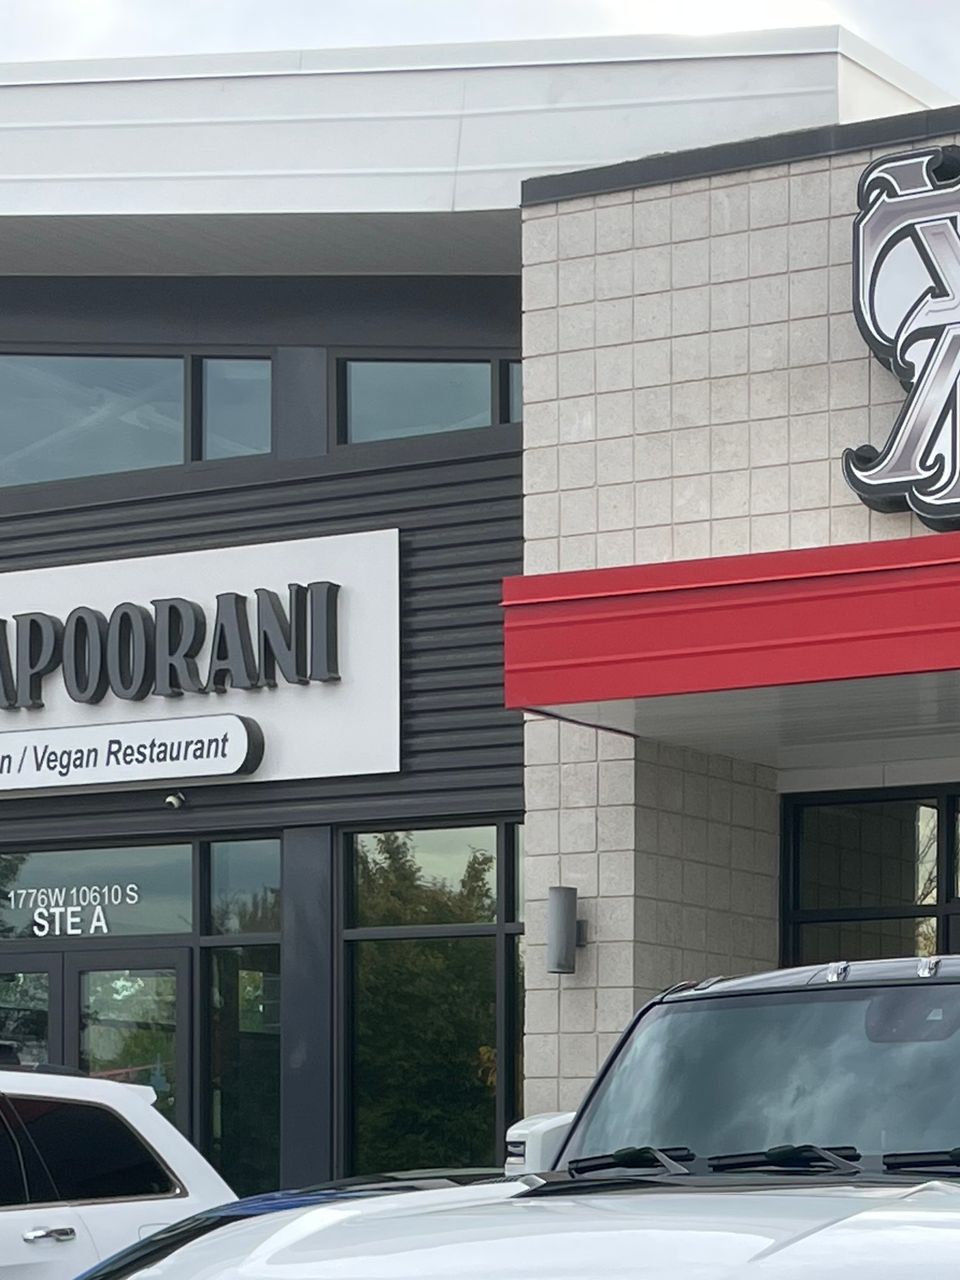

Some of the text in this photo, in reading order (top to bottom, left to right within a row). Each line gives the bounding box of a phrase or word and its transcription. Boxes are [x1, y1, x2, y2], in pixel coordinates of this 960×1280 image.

[33, 744, 98, 776] Vegan
[106, 732, 229, 766] Restaurant
[70, 884, 122, 906] 10610
[126, 884, 138, 904] S
[33, 905, 108, 936] STE A
